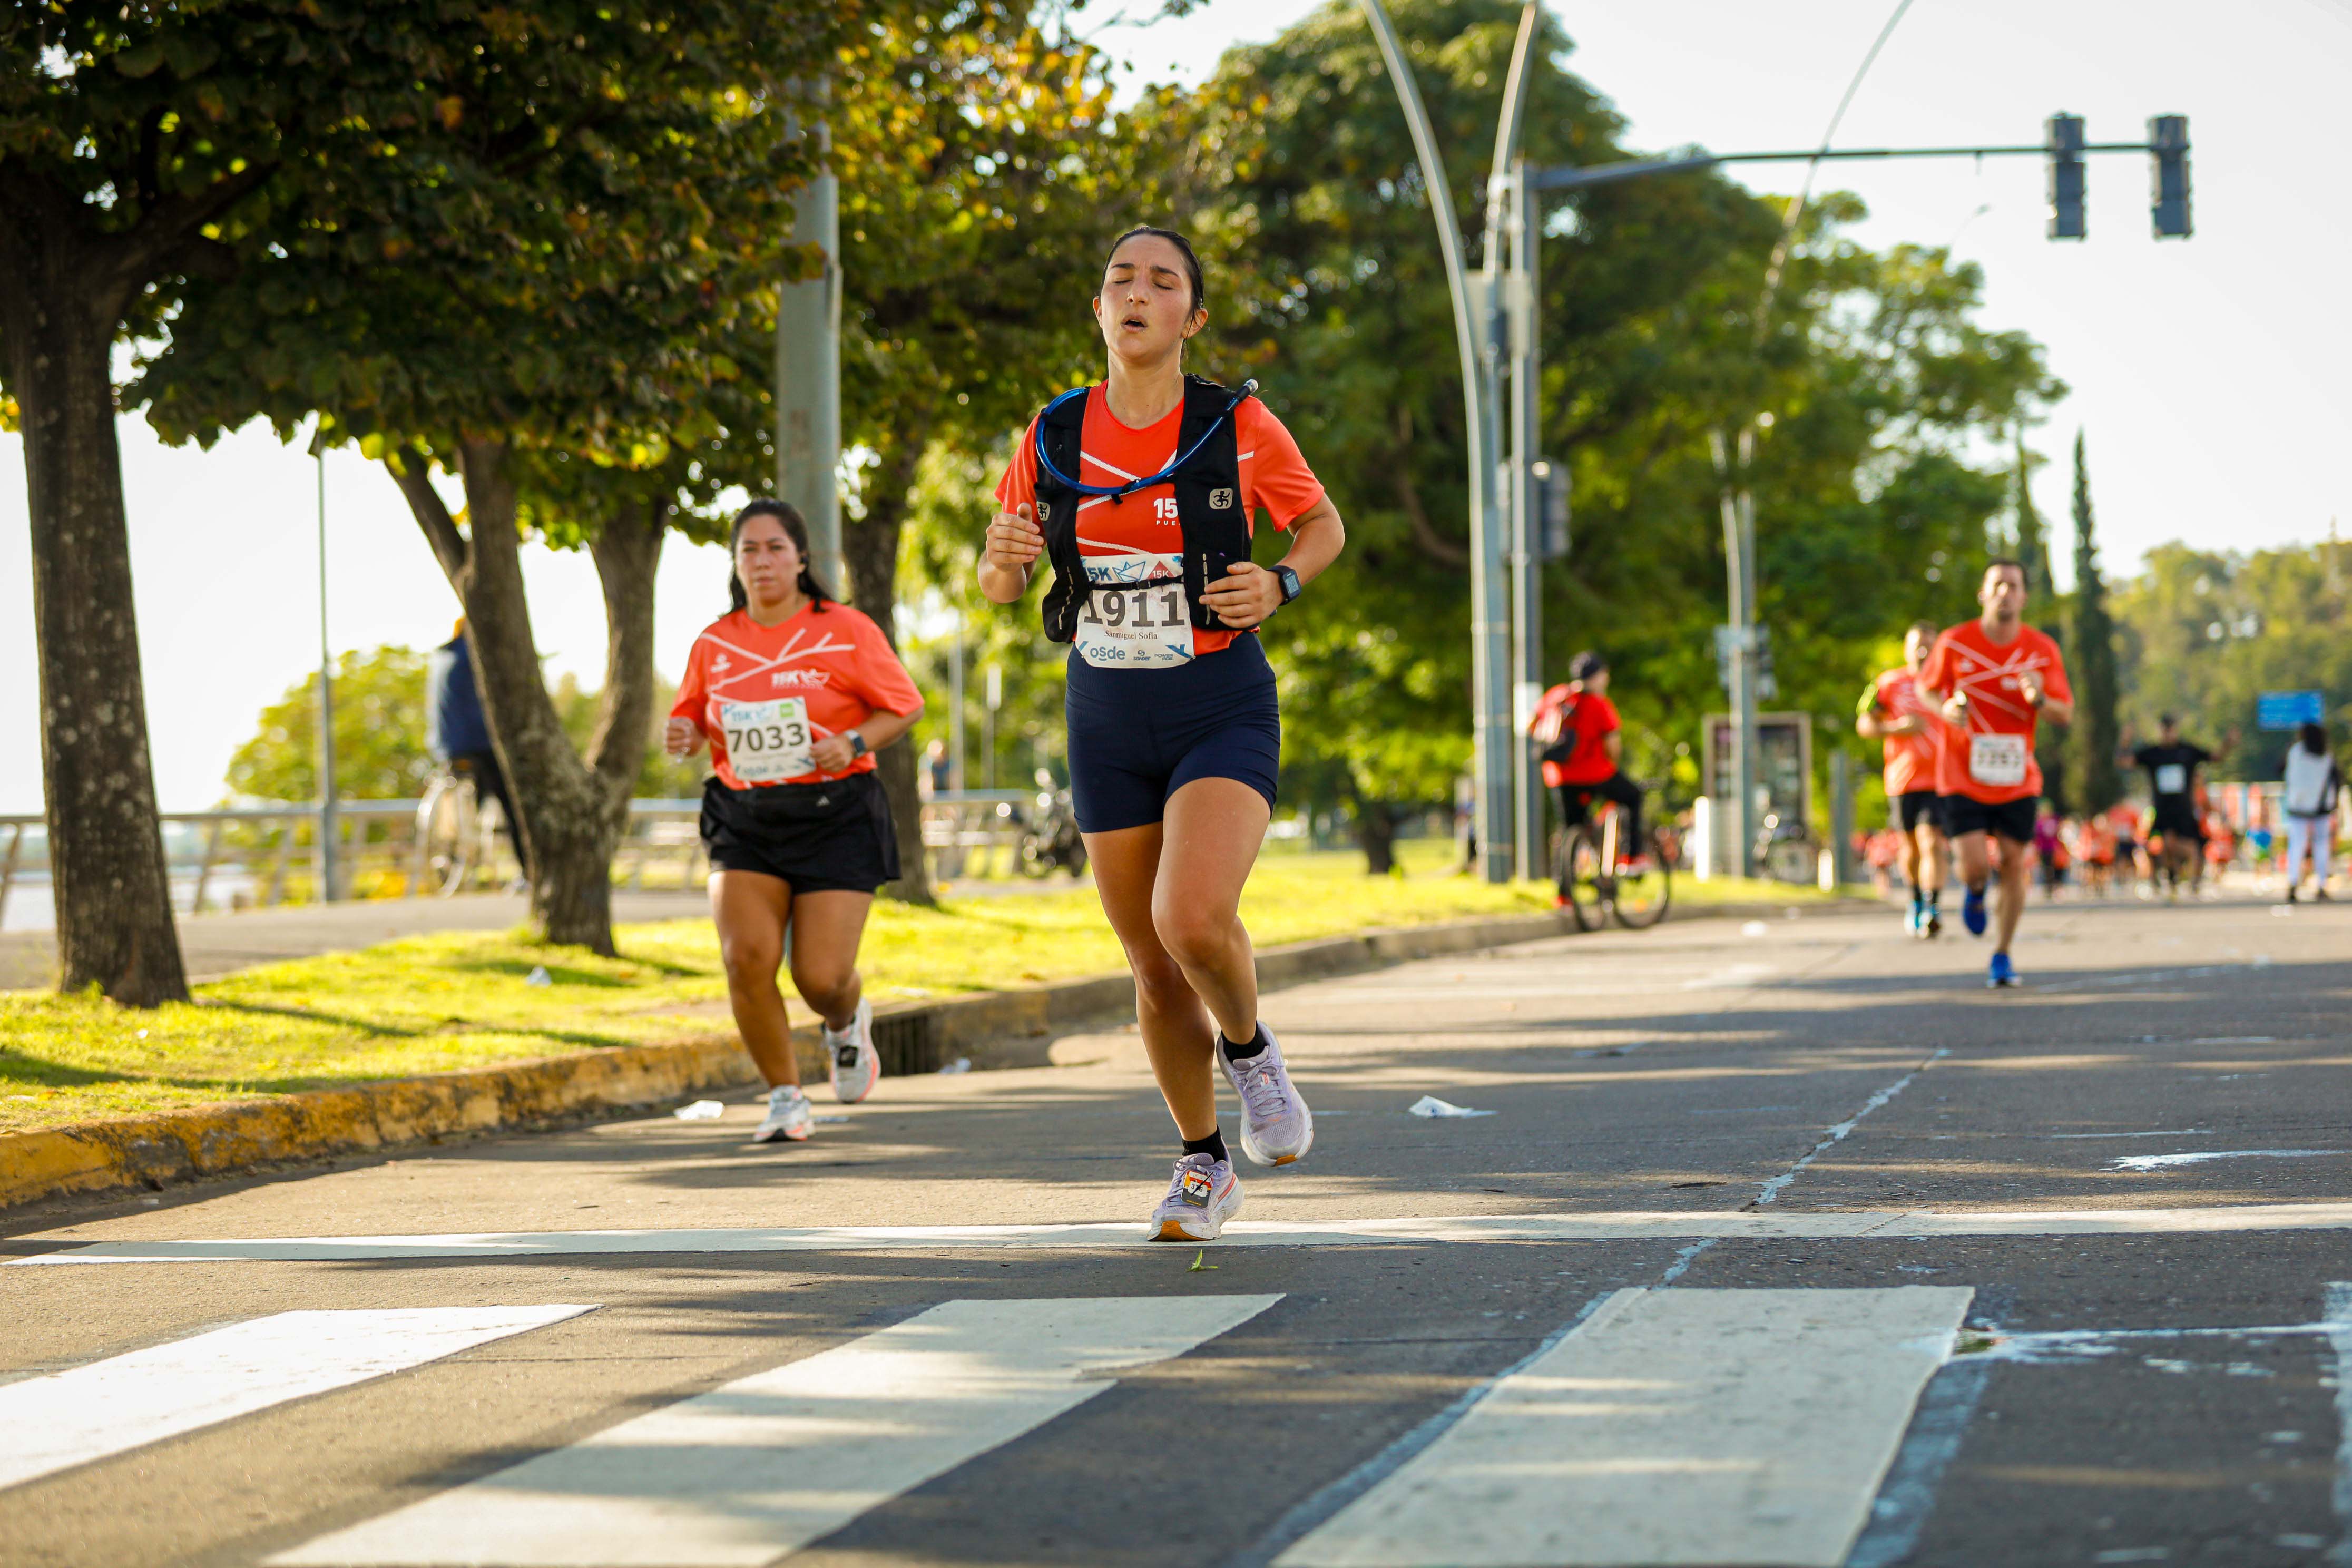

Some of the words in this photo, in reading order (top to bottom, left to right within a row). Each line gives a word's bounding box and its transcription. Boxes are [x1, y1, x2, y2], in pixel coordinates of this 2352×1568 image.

[1152, 570, 1169, 579] 15K
[1084, 591, 1185, 627] 1911
[1104, 630, 1136, 640] Sanmiguel
[1090, 646, 1126, 661] osde
[728, 723, 805, 753] 7033
